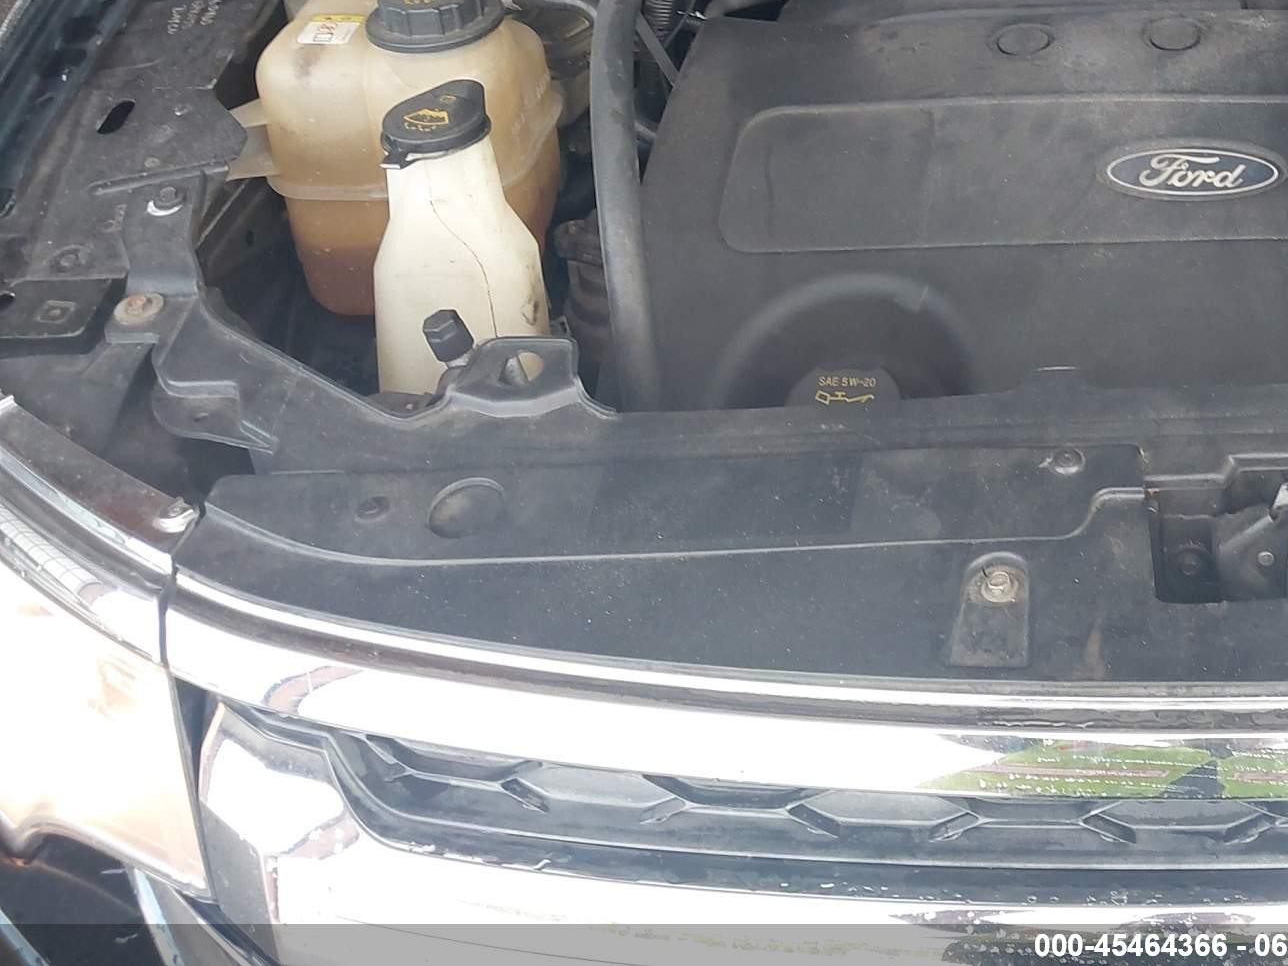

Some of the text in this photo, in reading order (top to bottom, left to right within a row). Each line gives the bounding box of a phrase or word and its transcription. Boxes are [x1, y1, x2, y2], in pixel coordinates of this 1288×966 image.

[1138, 153, 1247, 188] Ford
[817, 375, 877, 388] SAE 5W-20
